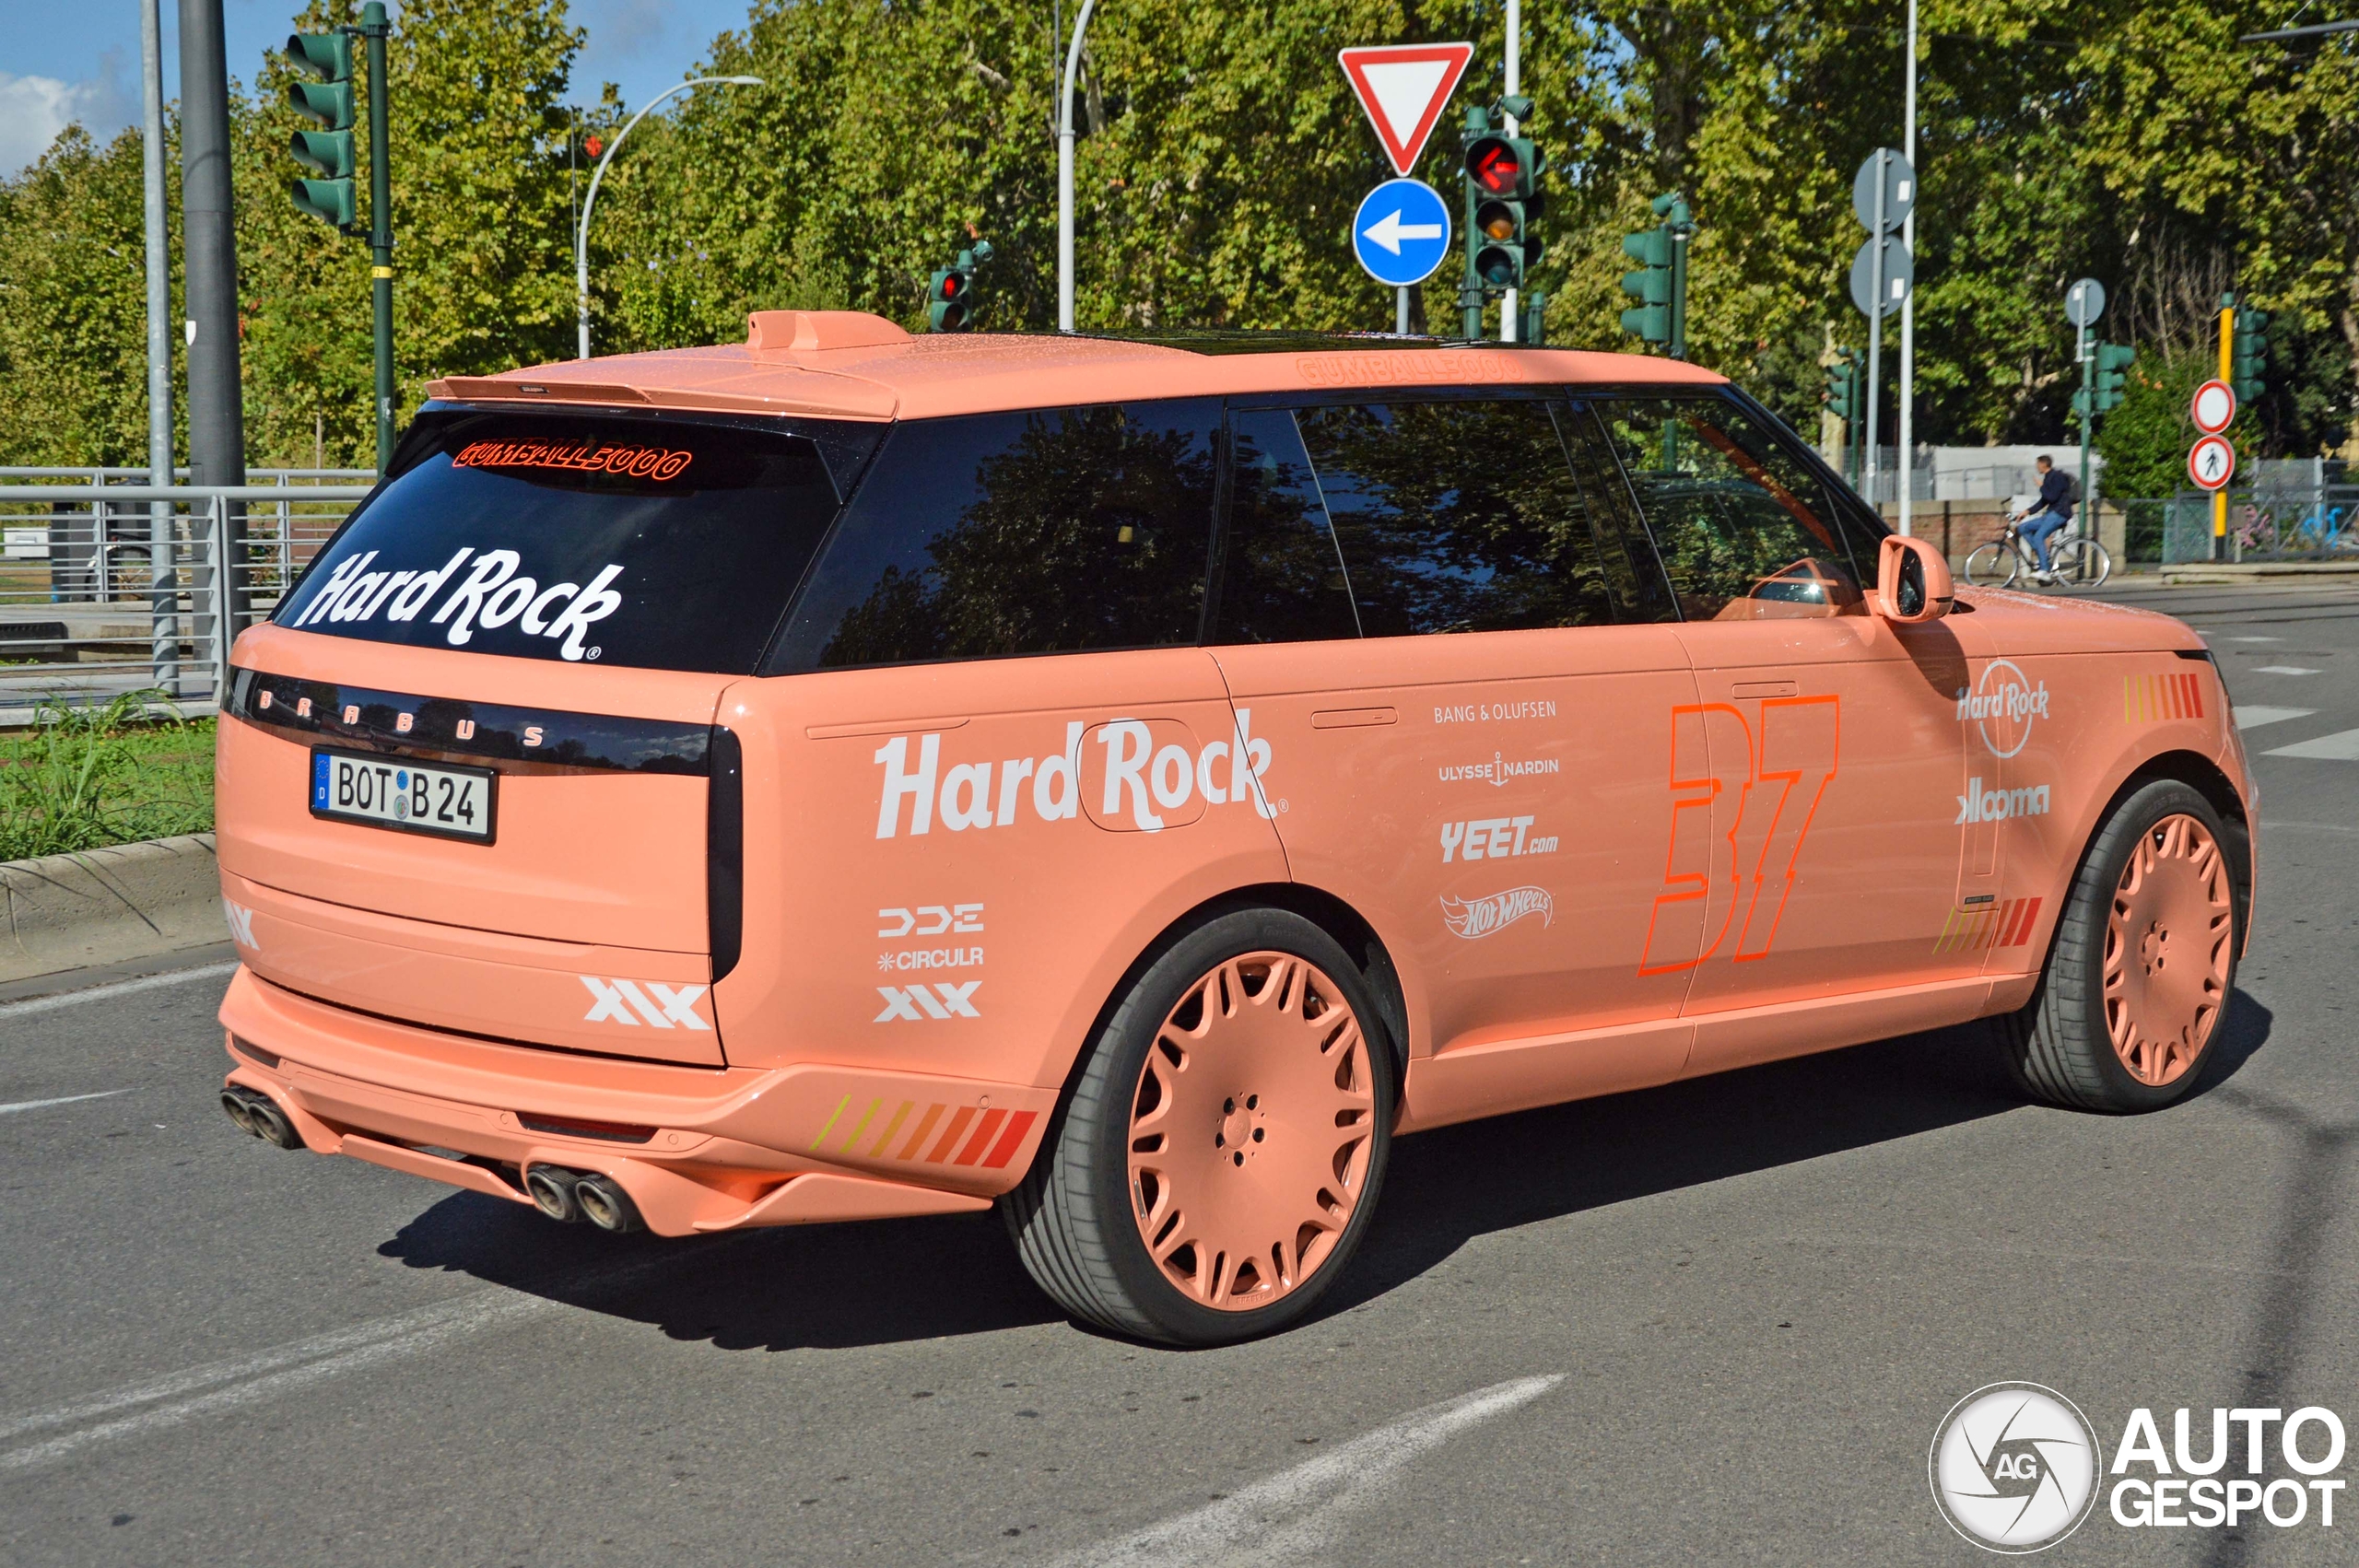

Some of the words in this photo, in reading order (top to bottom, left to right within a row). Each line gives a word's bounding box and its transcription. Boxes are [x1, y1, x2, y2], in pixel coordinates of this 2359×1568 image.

[1297, 354, 1523, 385] GUMBALL3000
[291, 546, 475, 628] Hard
[259, 690, 545, 748] BRABUS
[1434, 705, 1475, 723] BANG
[1480, 705, 1490, 721] &
[1492, 701, 1556, 720] OLUFSEN
[1955, 682, 2004, 721] Hard
[2006, 679, 2049, 724] Rock
[319, 786, 326, 801] D
[338, 761, 393, 813] BOT
[412, 772, 430, 818] B
[437, 776, 475, 825] 24
[874, 720, 1085, 839] Hard
[1438, 764, 1493, 781] ULYSSE
[1504, 758, 1559, 777] NARDIN
[1637, 694, 1839, 977] 37
[896, 946, 984, 970] CIRCULR
